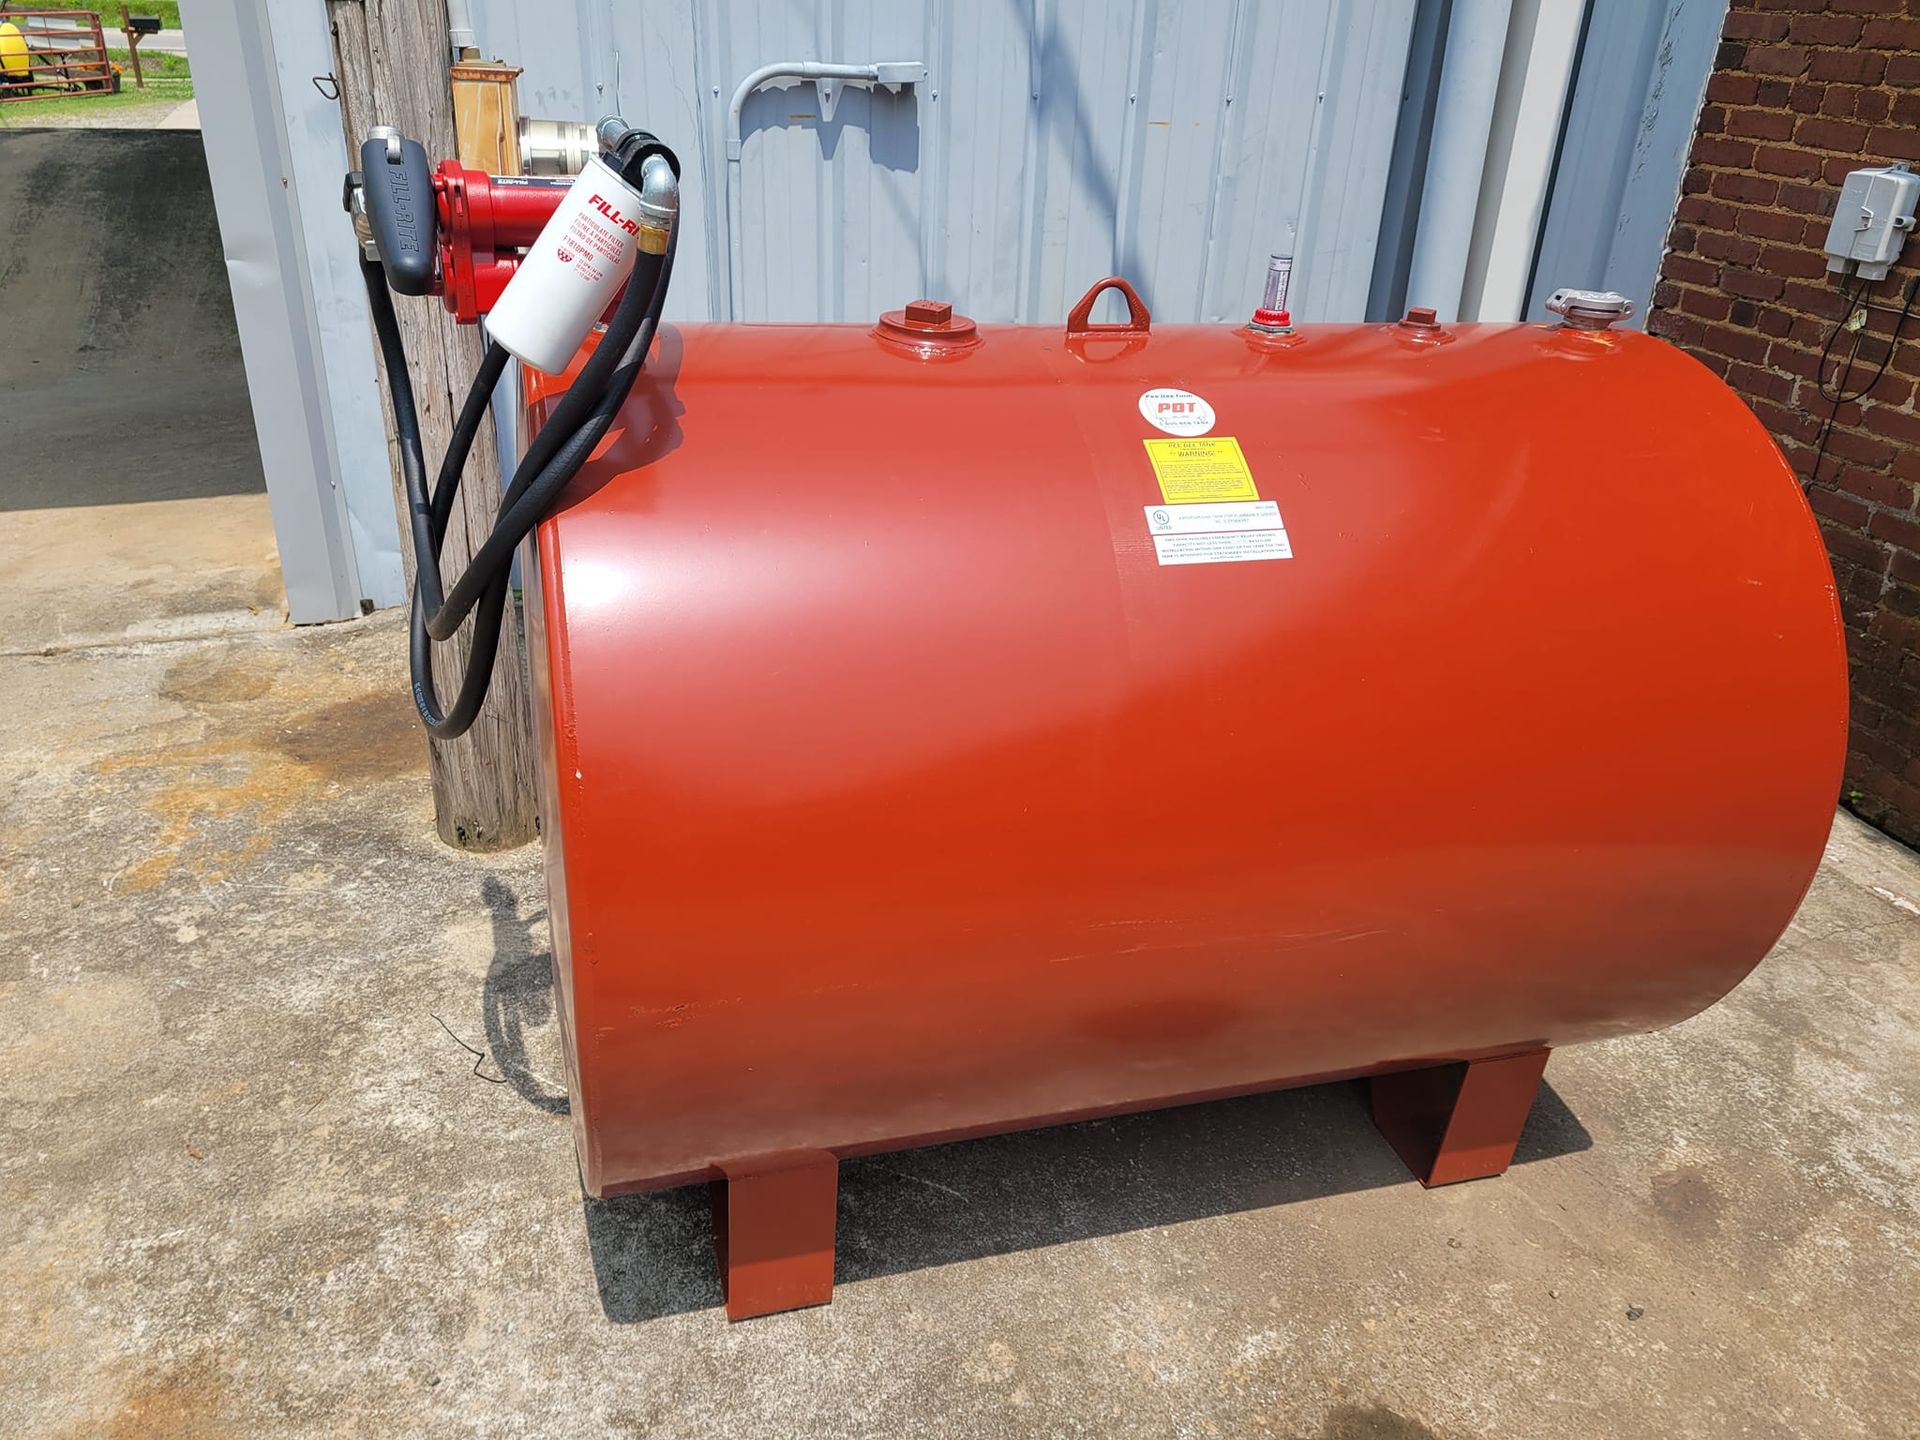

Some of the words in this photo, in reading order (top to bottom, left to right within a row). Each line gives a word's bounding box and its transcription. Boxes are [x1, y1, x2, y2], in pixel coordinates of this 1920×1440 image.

[389, 169, 420, 253] FILL-RITE
[577, 211, 610, 238] PARTICULATE
[608, 234, 625, 249] FILTER
[588, 194, 640, 239] FILL-RI
